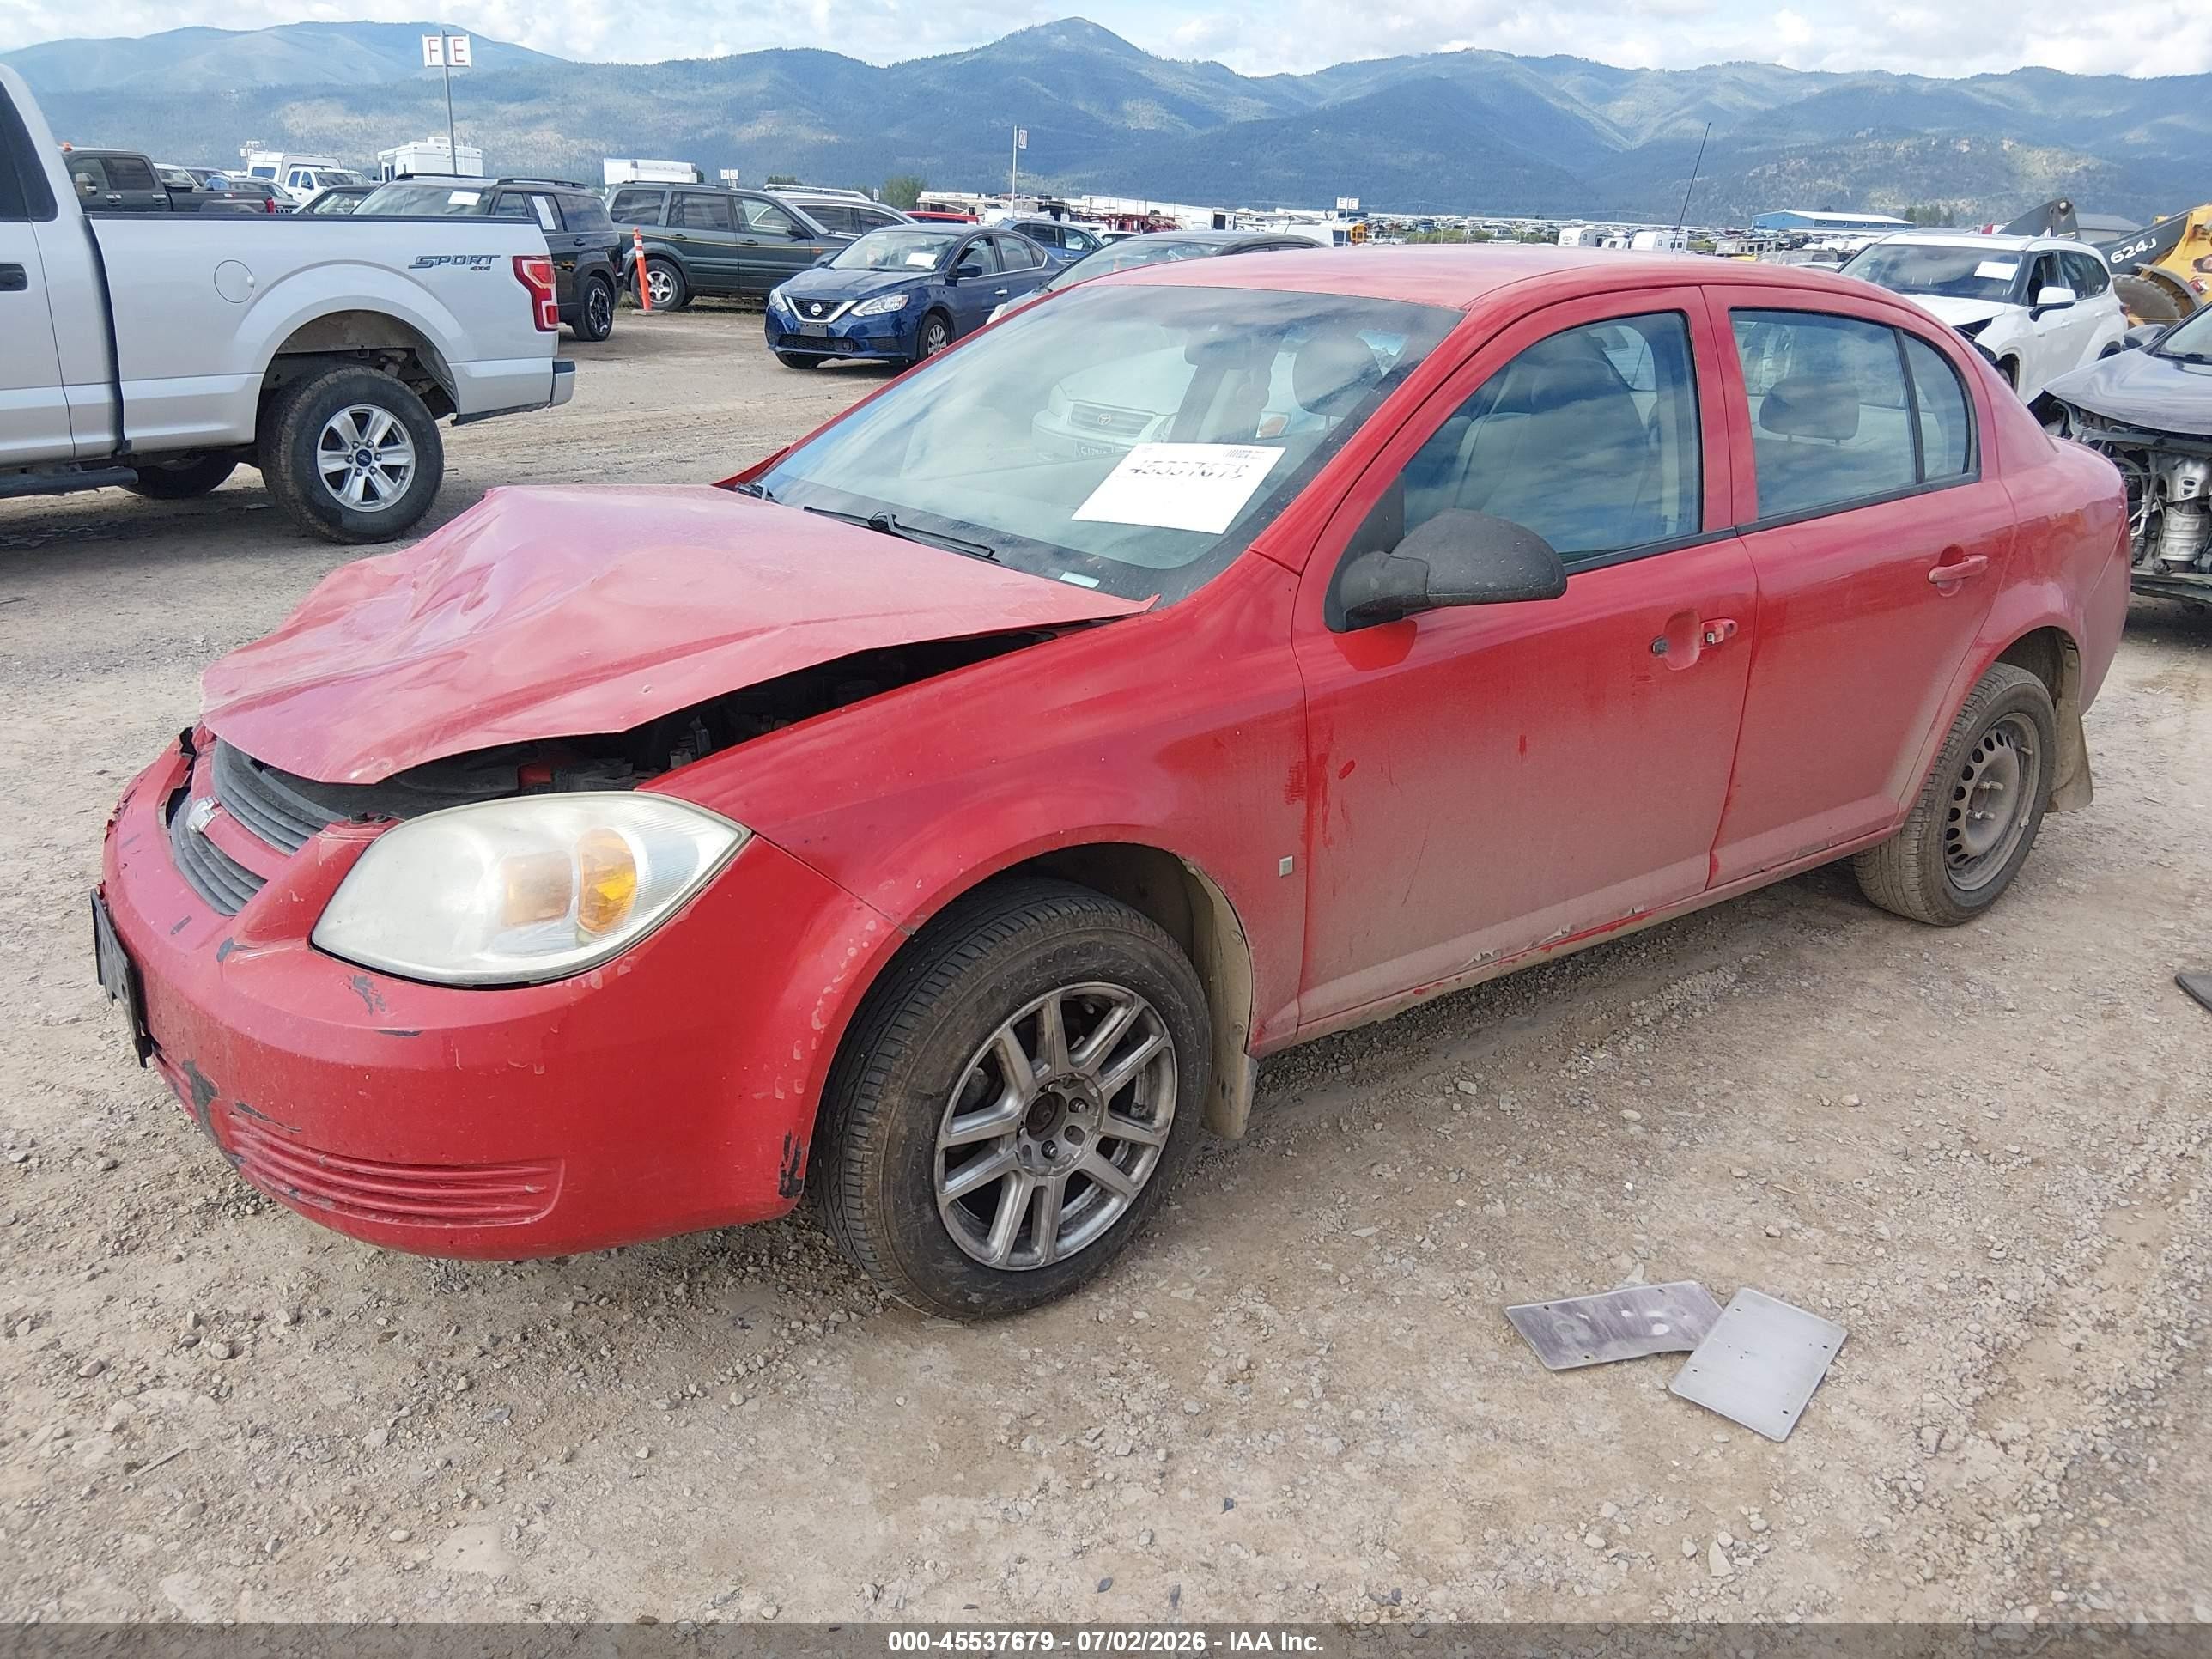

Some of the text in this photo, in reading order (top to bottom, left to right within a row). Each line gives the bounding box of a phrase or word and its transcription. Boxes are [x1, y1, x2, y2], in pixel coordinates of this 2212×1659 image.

[428, 39, 466, 63] F E
[408, 254, 501, 269] SPORT
[2110, 237, 2157, 264] 624J
